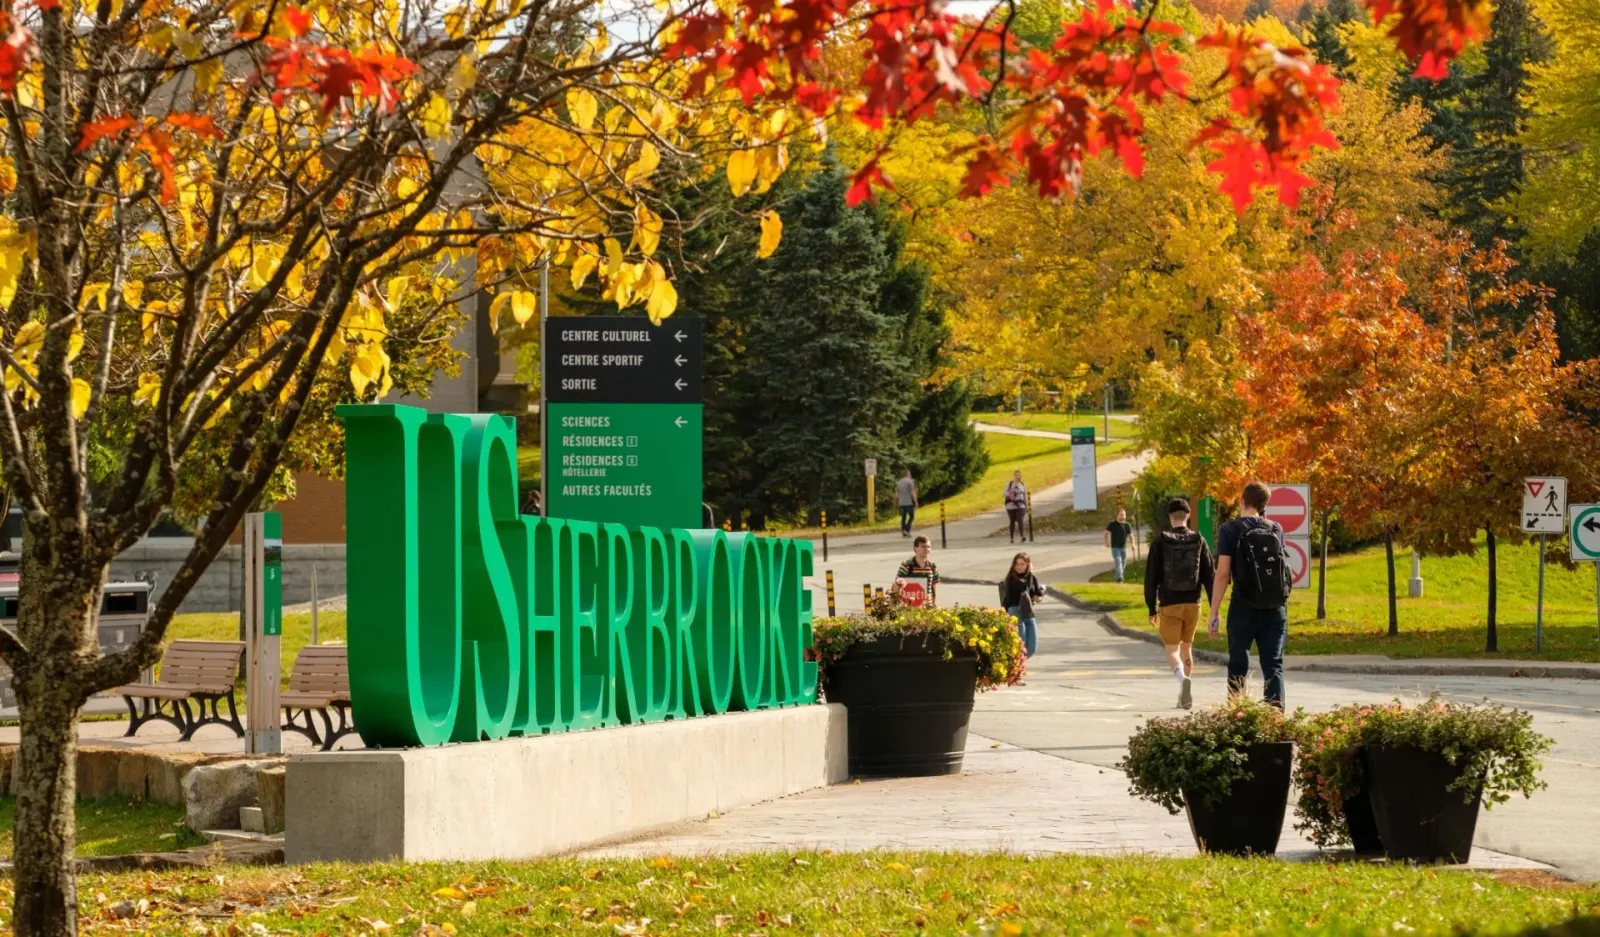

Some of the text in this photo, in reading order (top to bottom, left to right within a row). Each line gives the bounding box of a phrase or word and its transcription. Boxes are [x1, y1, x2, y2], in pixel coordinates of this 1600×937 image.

[561, 330, 651, 342] CENTRE CULTUREL
[561, 354, 644, 366] CENTRE SPORTIF
[561, 378, 597, 390] SORTIE
[561, 416, 610, 427] SCIENCES
[562, 434, 624, 447] RÉSIDENCES
[562, 454, 624, 466] RÉSIDENCES
[562, 467, 607, 477] HÔTELLERIE
[562, 483, 652, 496] AUTRES FACULTÉS
